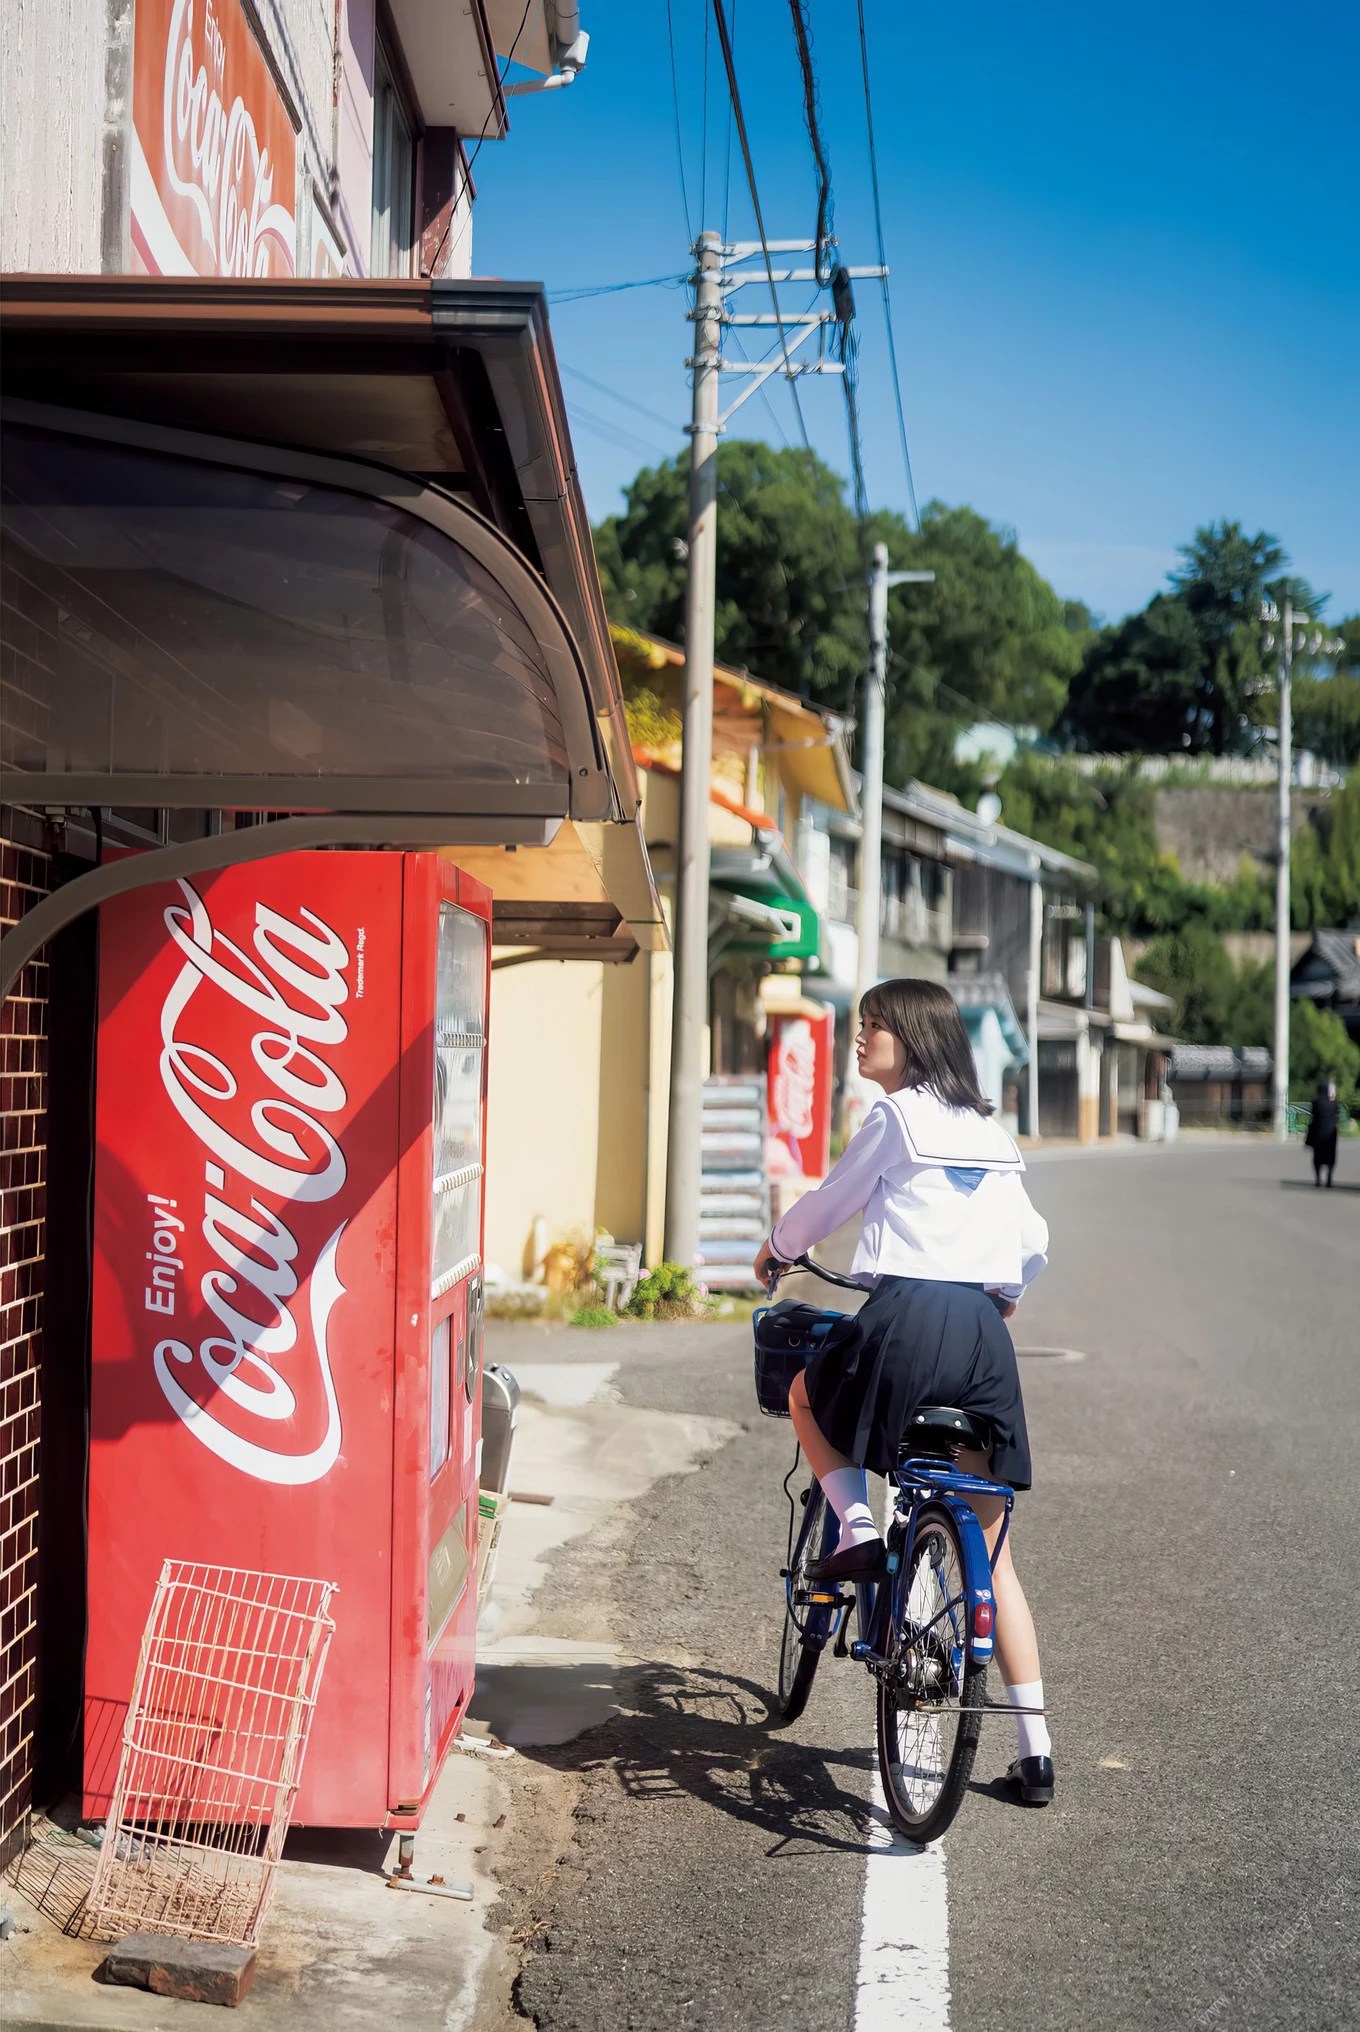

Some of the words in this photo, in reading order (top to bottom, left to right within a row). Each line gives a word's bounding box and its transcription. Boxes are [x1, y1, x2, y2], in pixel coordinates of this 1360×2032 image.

[355, 952, 365, 998] Trademark
[153, 877, 351, 1485] Coca-Cola
[145, 1194, 185, 1316] Enjoy!
